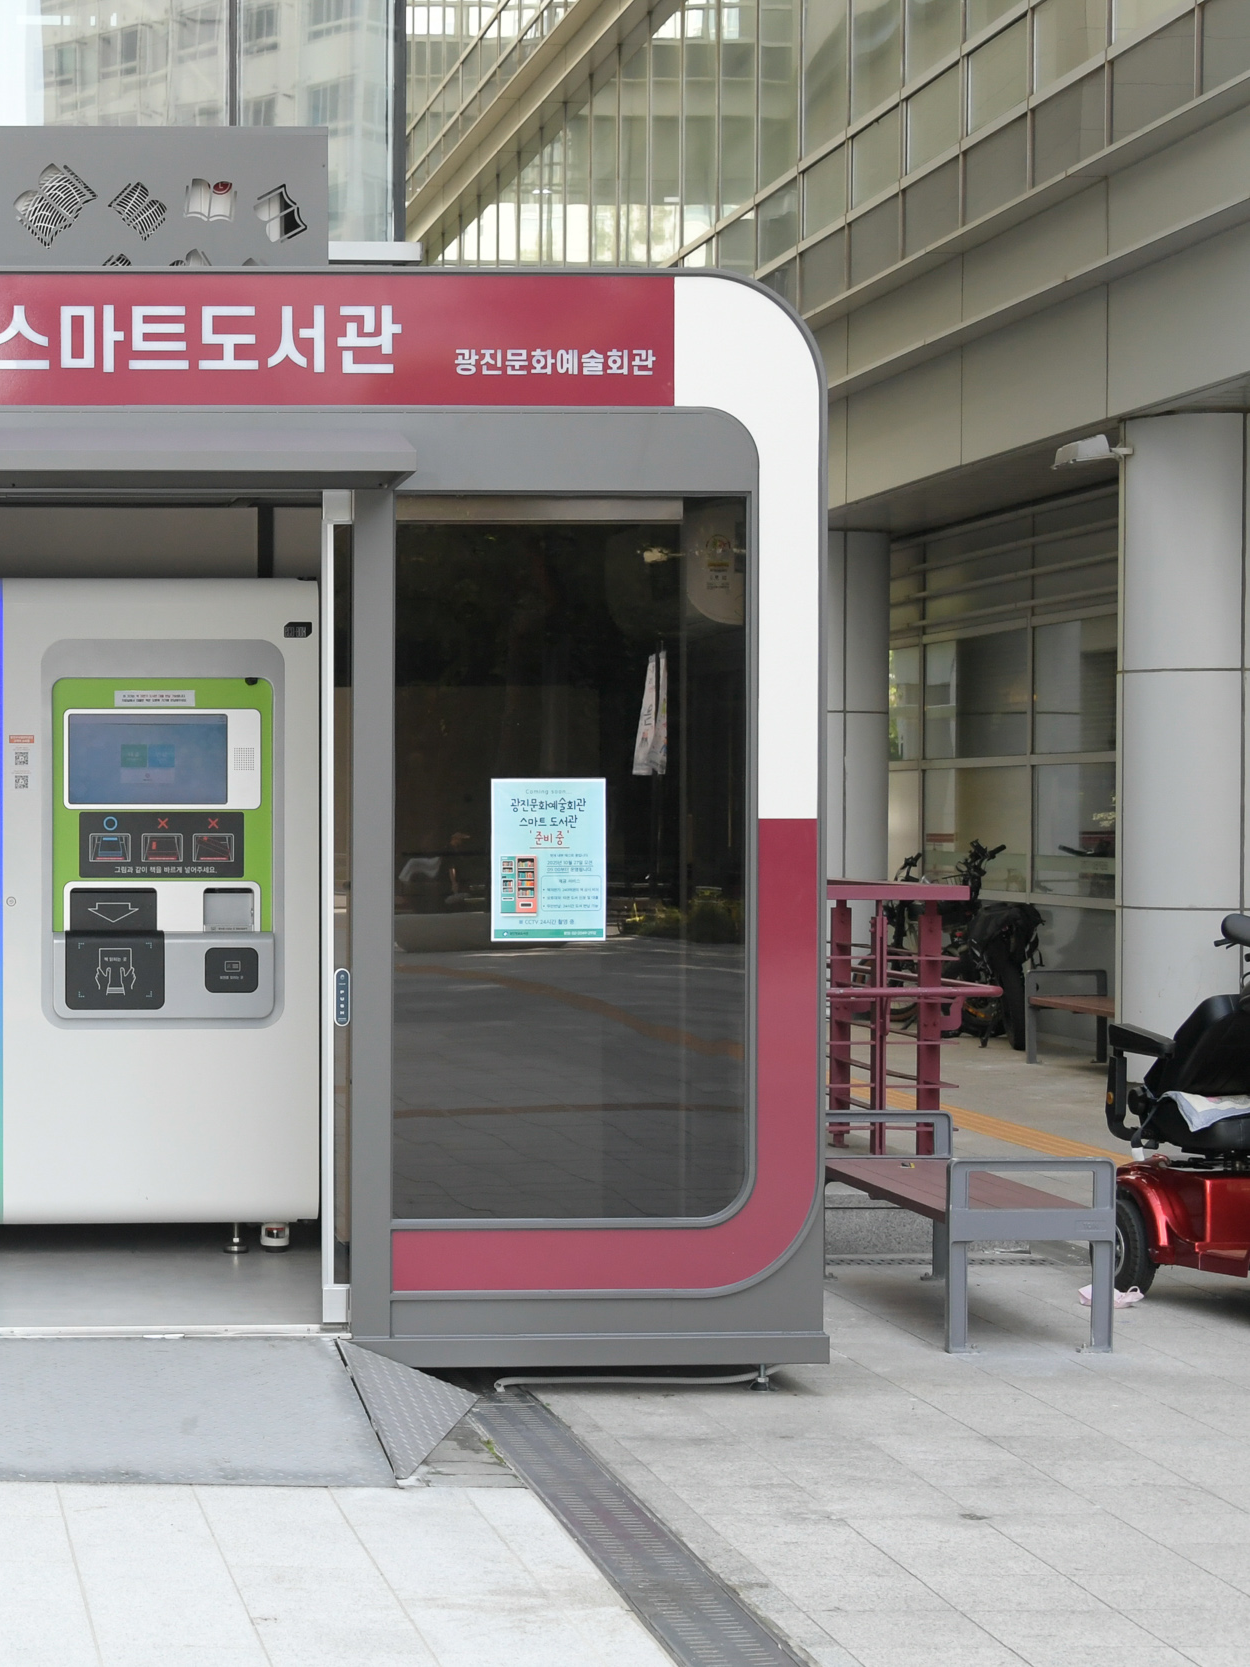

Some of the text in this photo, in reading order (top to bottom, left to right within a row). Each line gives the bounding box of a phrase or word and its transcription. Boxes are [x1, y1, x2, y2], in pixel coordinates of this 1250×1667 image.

[454, 348, 656, 375] 광진문화예술회관
[510, 797, 587, 813] 광진문화예술회관
[519, 814, 578, 829] 스마트 도서관
[114, 866, 133, 874] 그림과
[135, 866, 148, 874] 같이
[149, 866, 162, 874] 책을
[163, 866, 183, 874] 바르게
